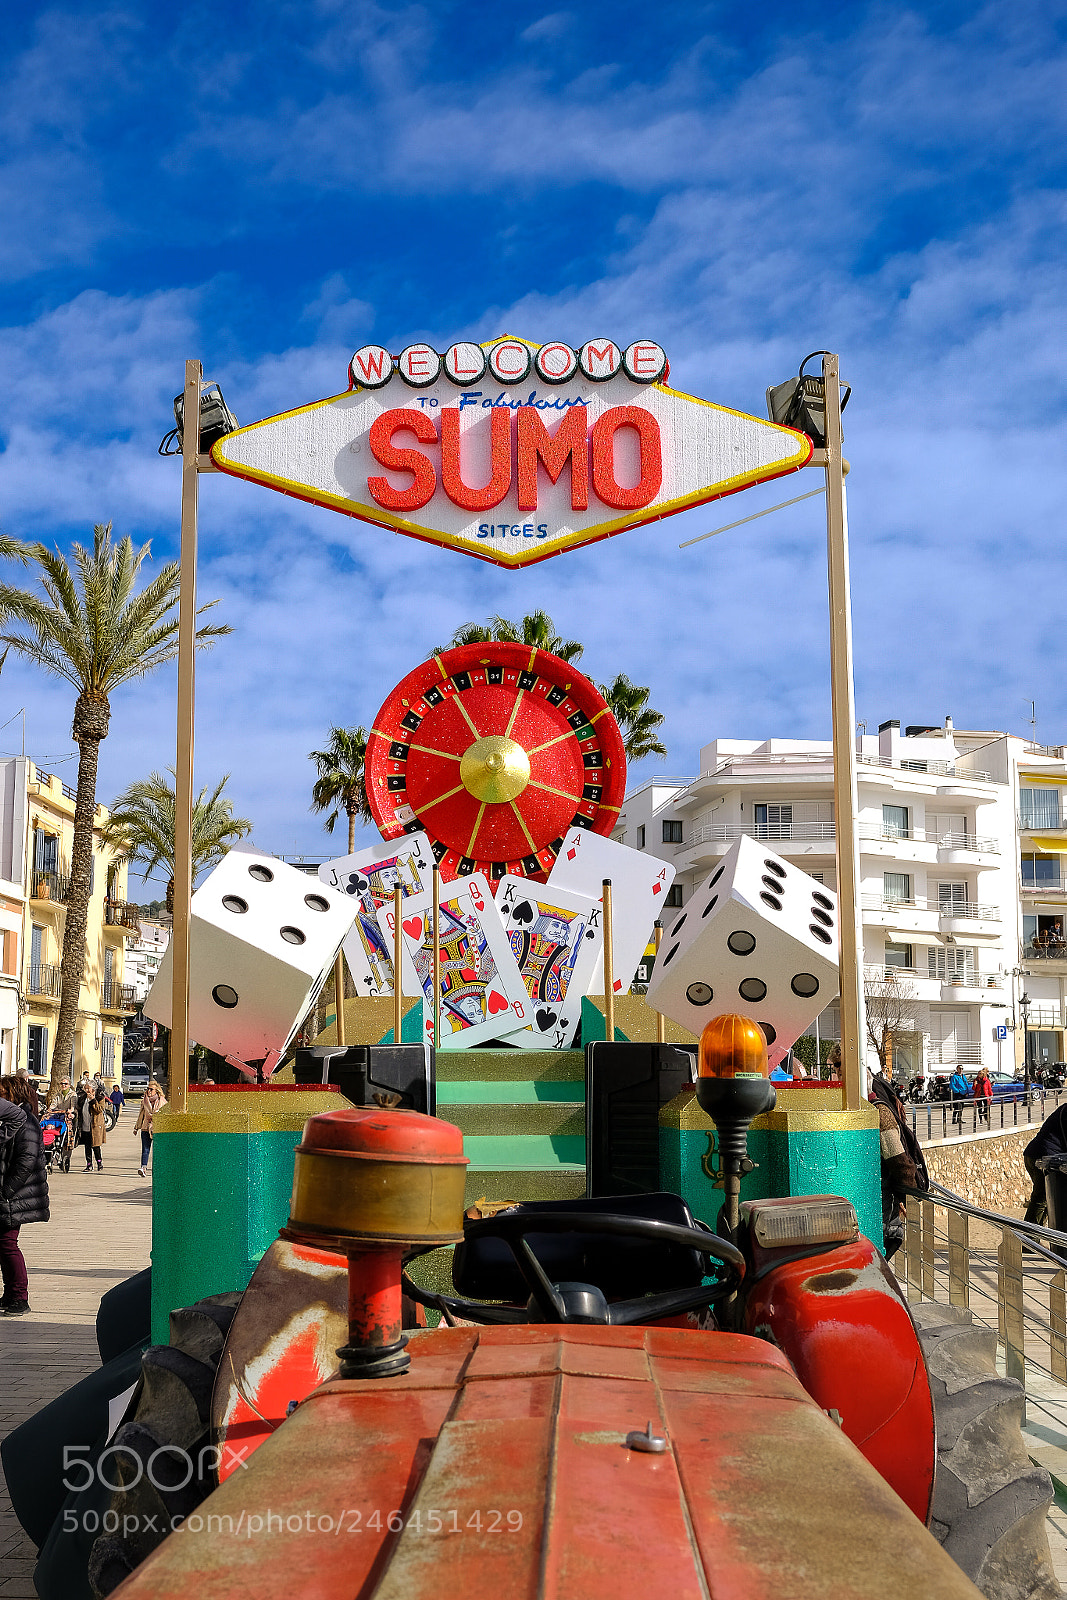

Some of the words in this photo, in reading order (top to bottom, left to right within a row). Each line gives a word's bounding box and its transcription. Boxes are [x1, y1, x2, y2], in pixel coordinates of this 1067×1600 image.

[355, 344, 659, 381] WELCOME
[416, 397, 439, 408] TO
[459, 390, 592, 411] Fabulous
[367, 405, 663, 512] SUMO
[476, 524, 549, 539] SITGES
[538, 684, 547, 692] 11
[551, 692, 561, 701] 22
[571, 833, 581, 846] A
[412, 840, 421, 857] J
[329, 868, 338, 886] J
[656, 867, 666, 880] A
[469, 881, 483, 899] Q
[503, 883, 517, 902] K
[588, 909, 602, 927] K
[511, 1001, 525, 1018] Q
